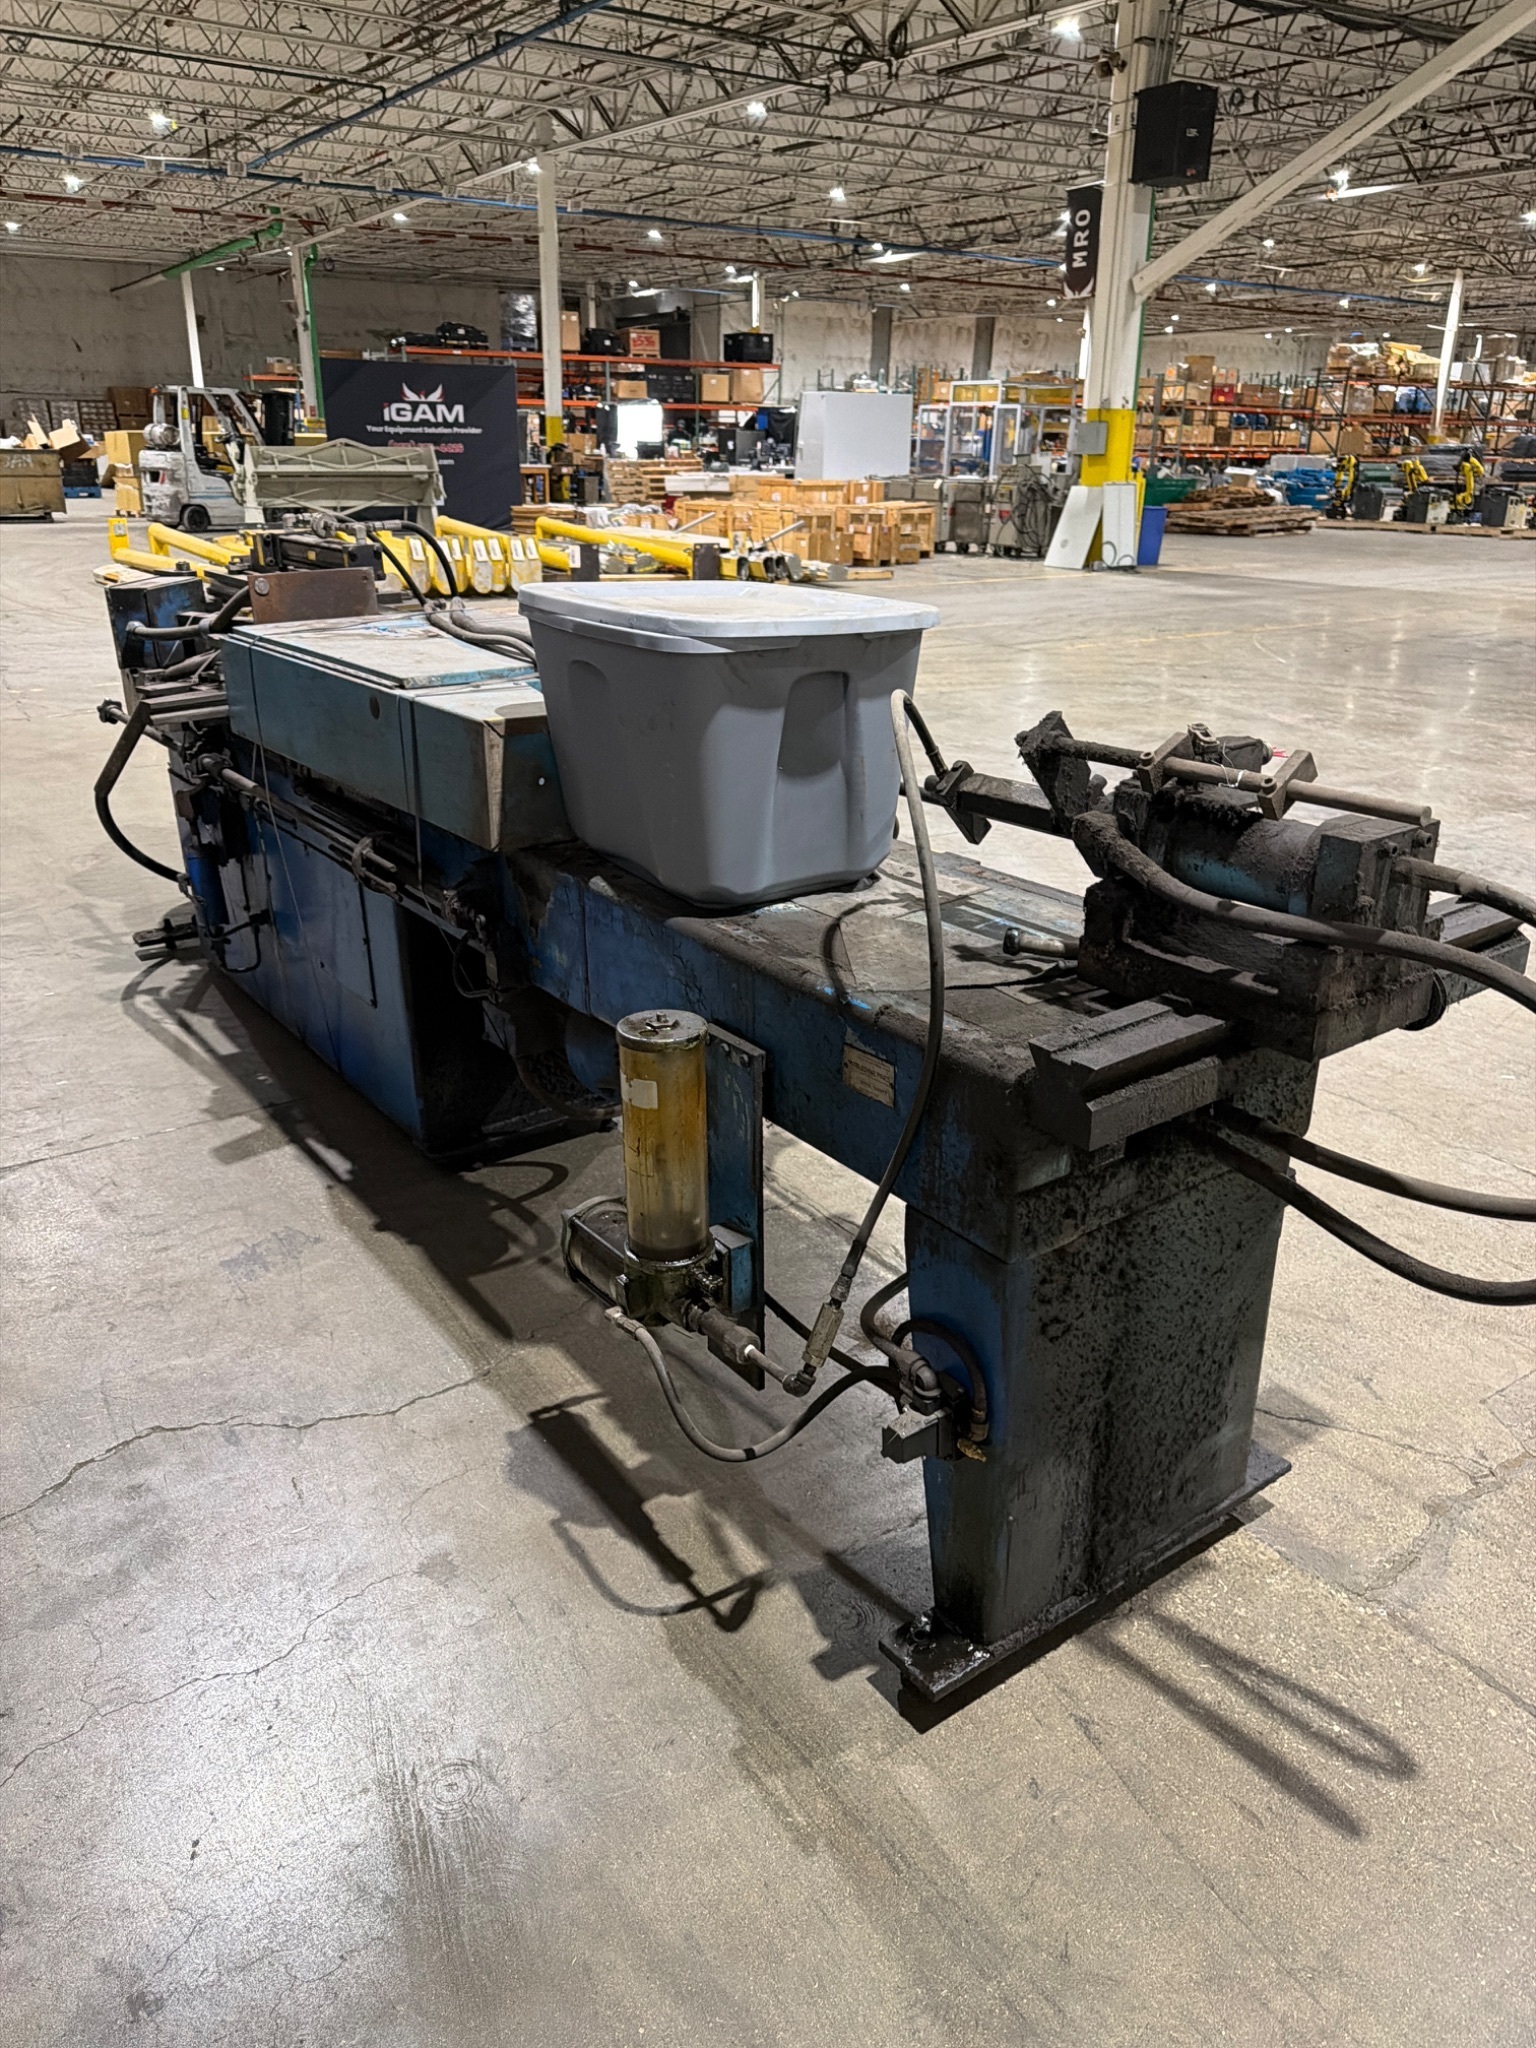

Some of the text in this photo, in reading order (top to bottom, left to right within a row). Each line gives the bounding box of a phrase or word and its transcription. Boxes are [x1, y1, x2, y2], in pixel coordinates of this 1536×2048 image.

[1072, 208, 1091, 268] MRO
[383, 402, 465, 423] iGAM
[366, 425, 482, 435] Your Equipment Solution Provider
